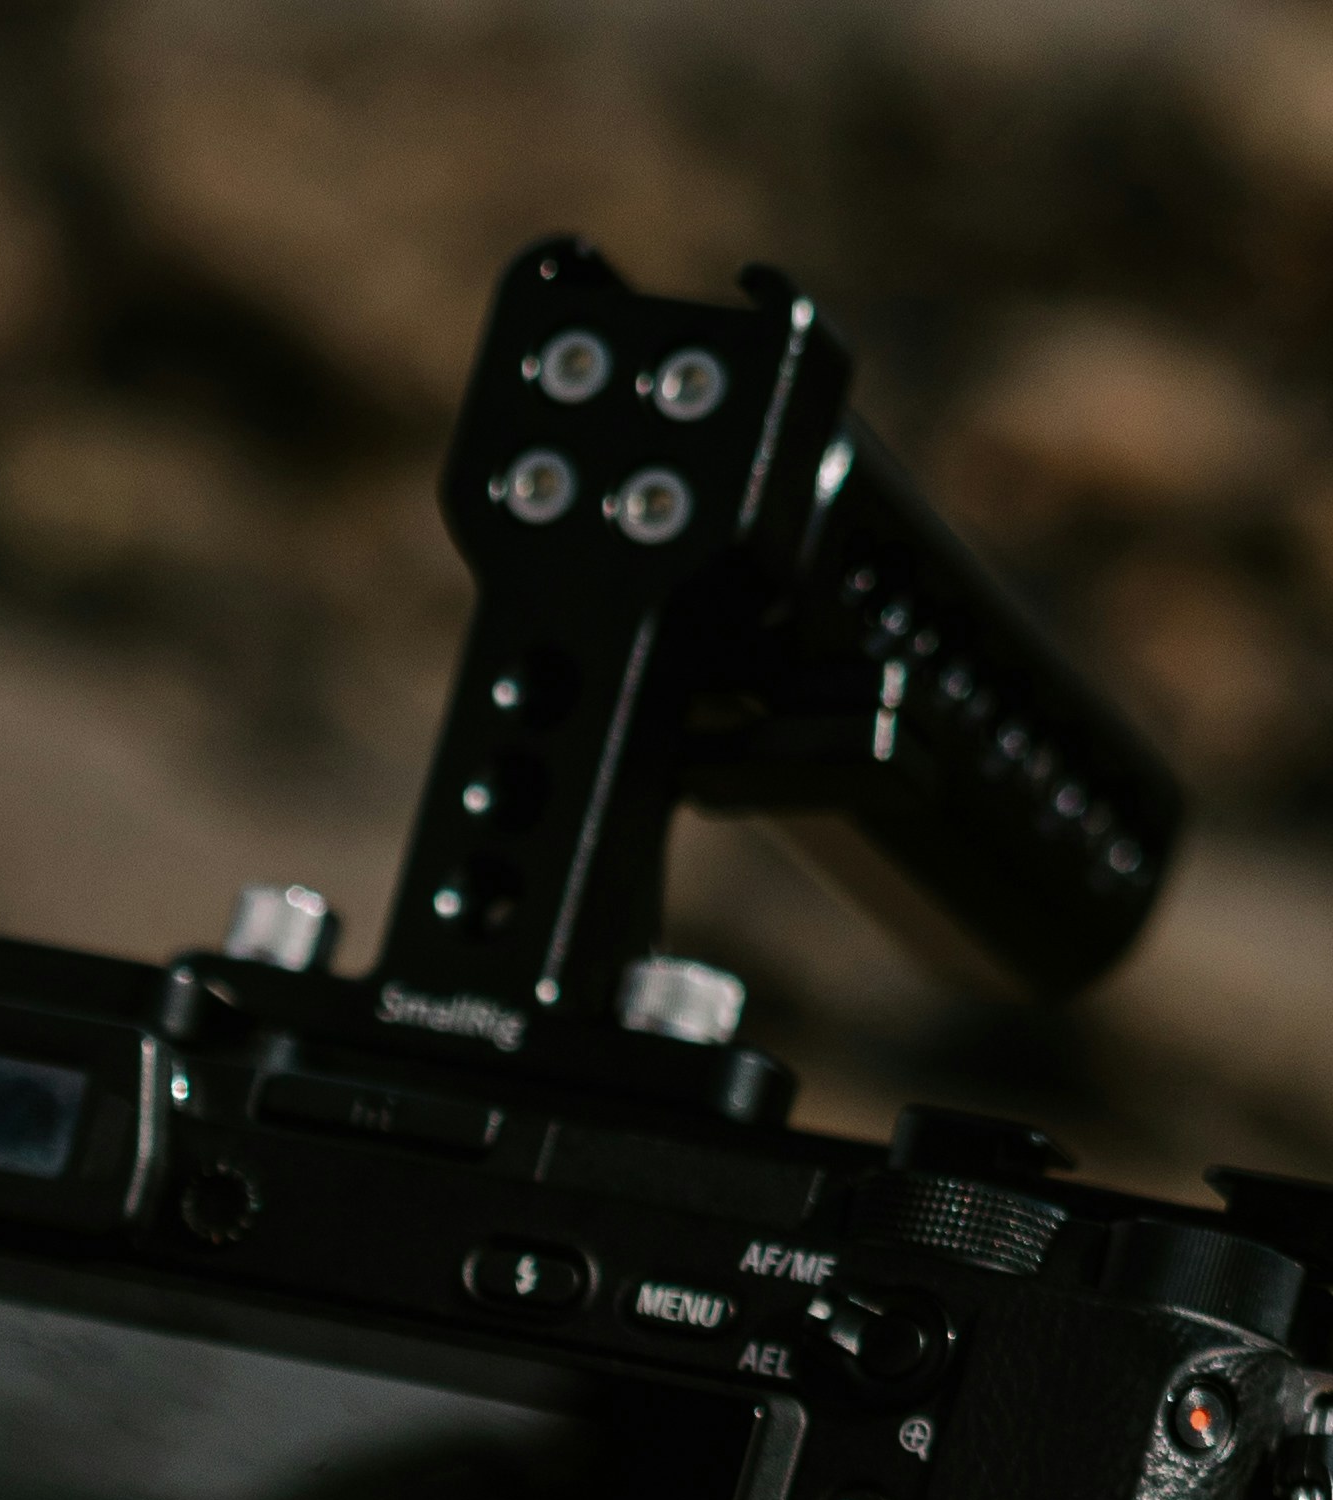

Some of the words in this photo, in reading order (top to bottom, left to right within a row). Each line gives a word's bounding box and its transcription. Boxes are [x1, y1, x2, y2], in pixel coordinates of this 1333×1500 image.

[740, 1241, 837, 1287] AF/MF
[635, 1281, 723, 1330] MENU
[737, 1343, 793, 1381] AEL
